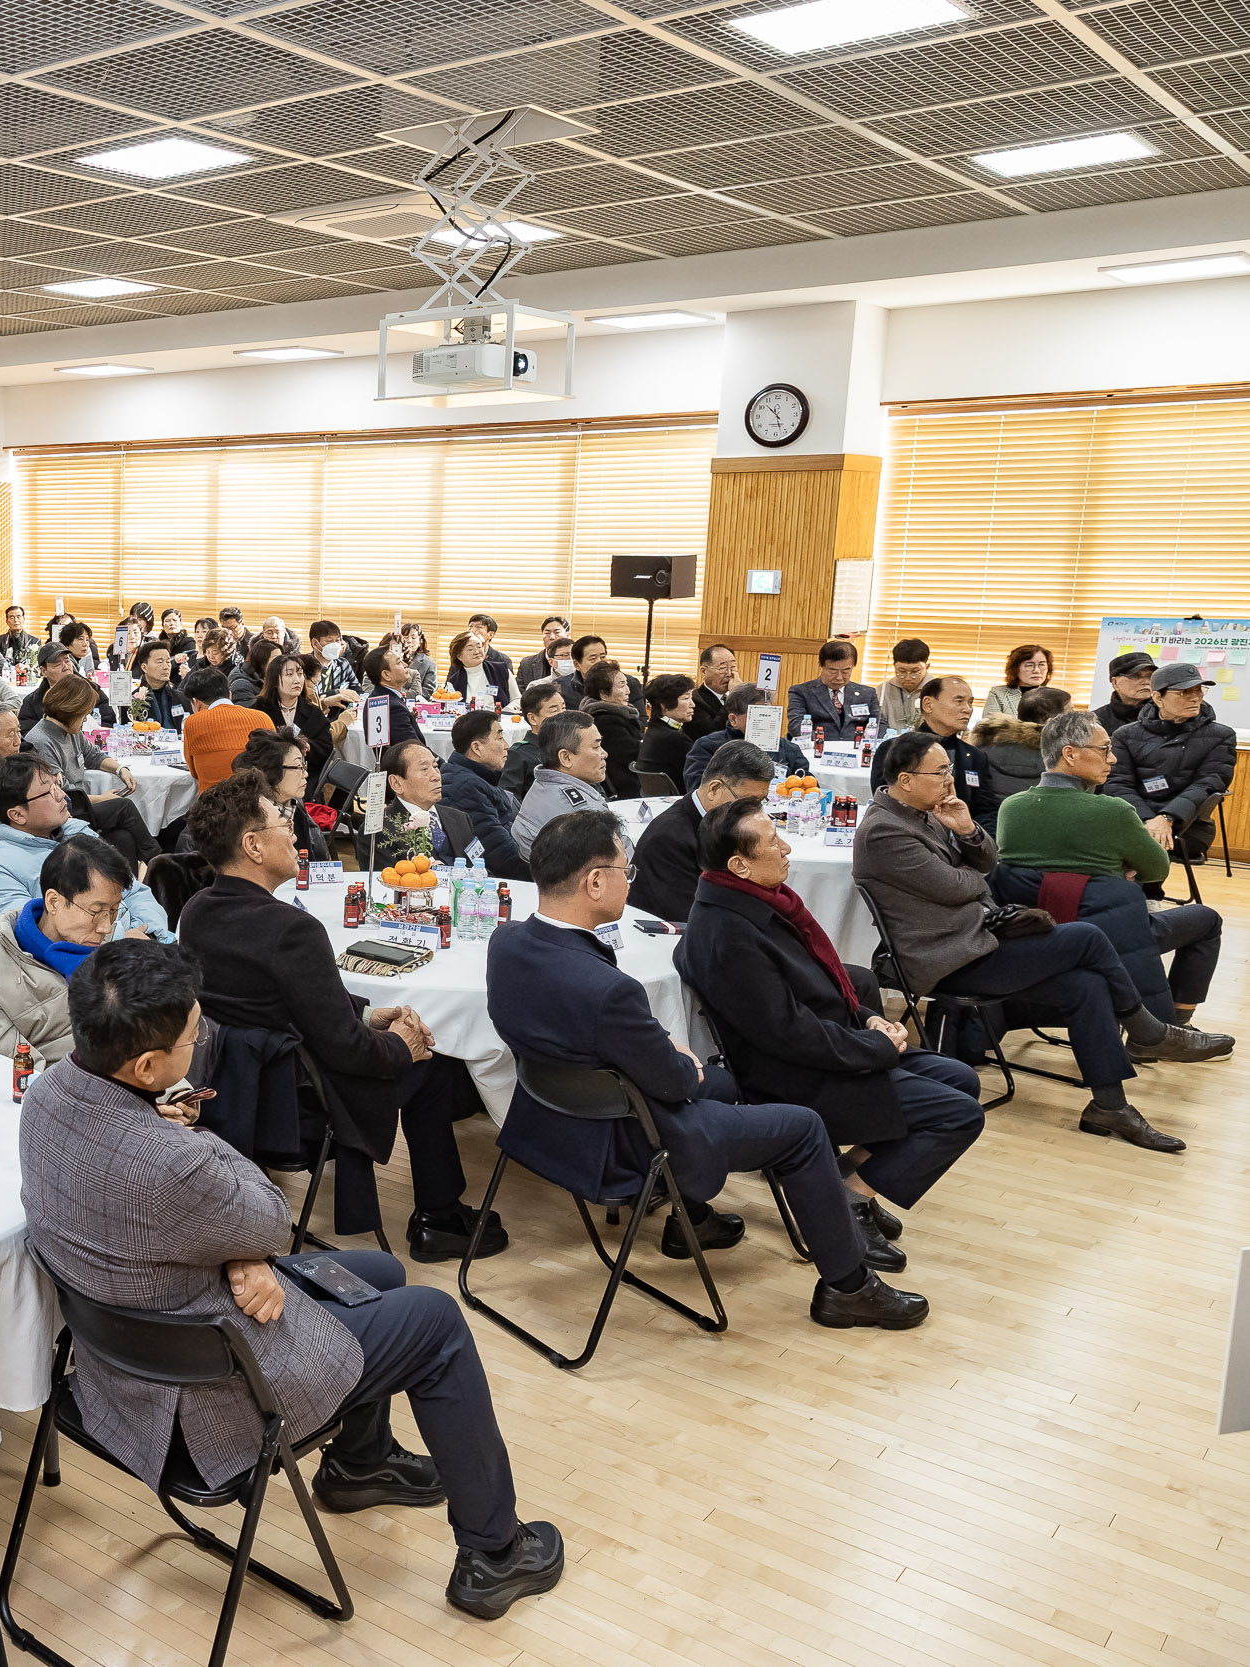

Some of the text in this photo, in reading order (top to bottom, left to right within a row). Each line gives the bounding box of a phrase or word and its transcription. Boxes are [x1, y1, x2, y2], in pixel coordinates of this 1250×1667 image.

[118, 637, 123, 646] 6
[1150, 636, 1166, 644] 내가
[1169, 637, 1192, 645] 바라는
[1194, 637, 1228, 645] 2026년
[764, 668, 772, 681] 2
[375, 716, 382, 733] 3
